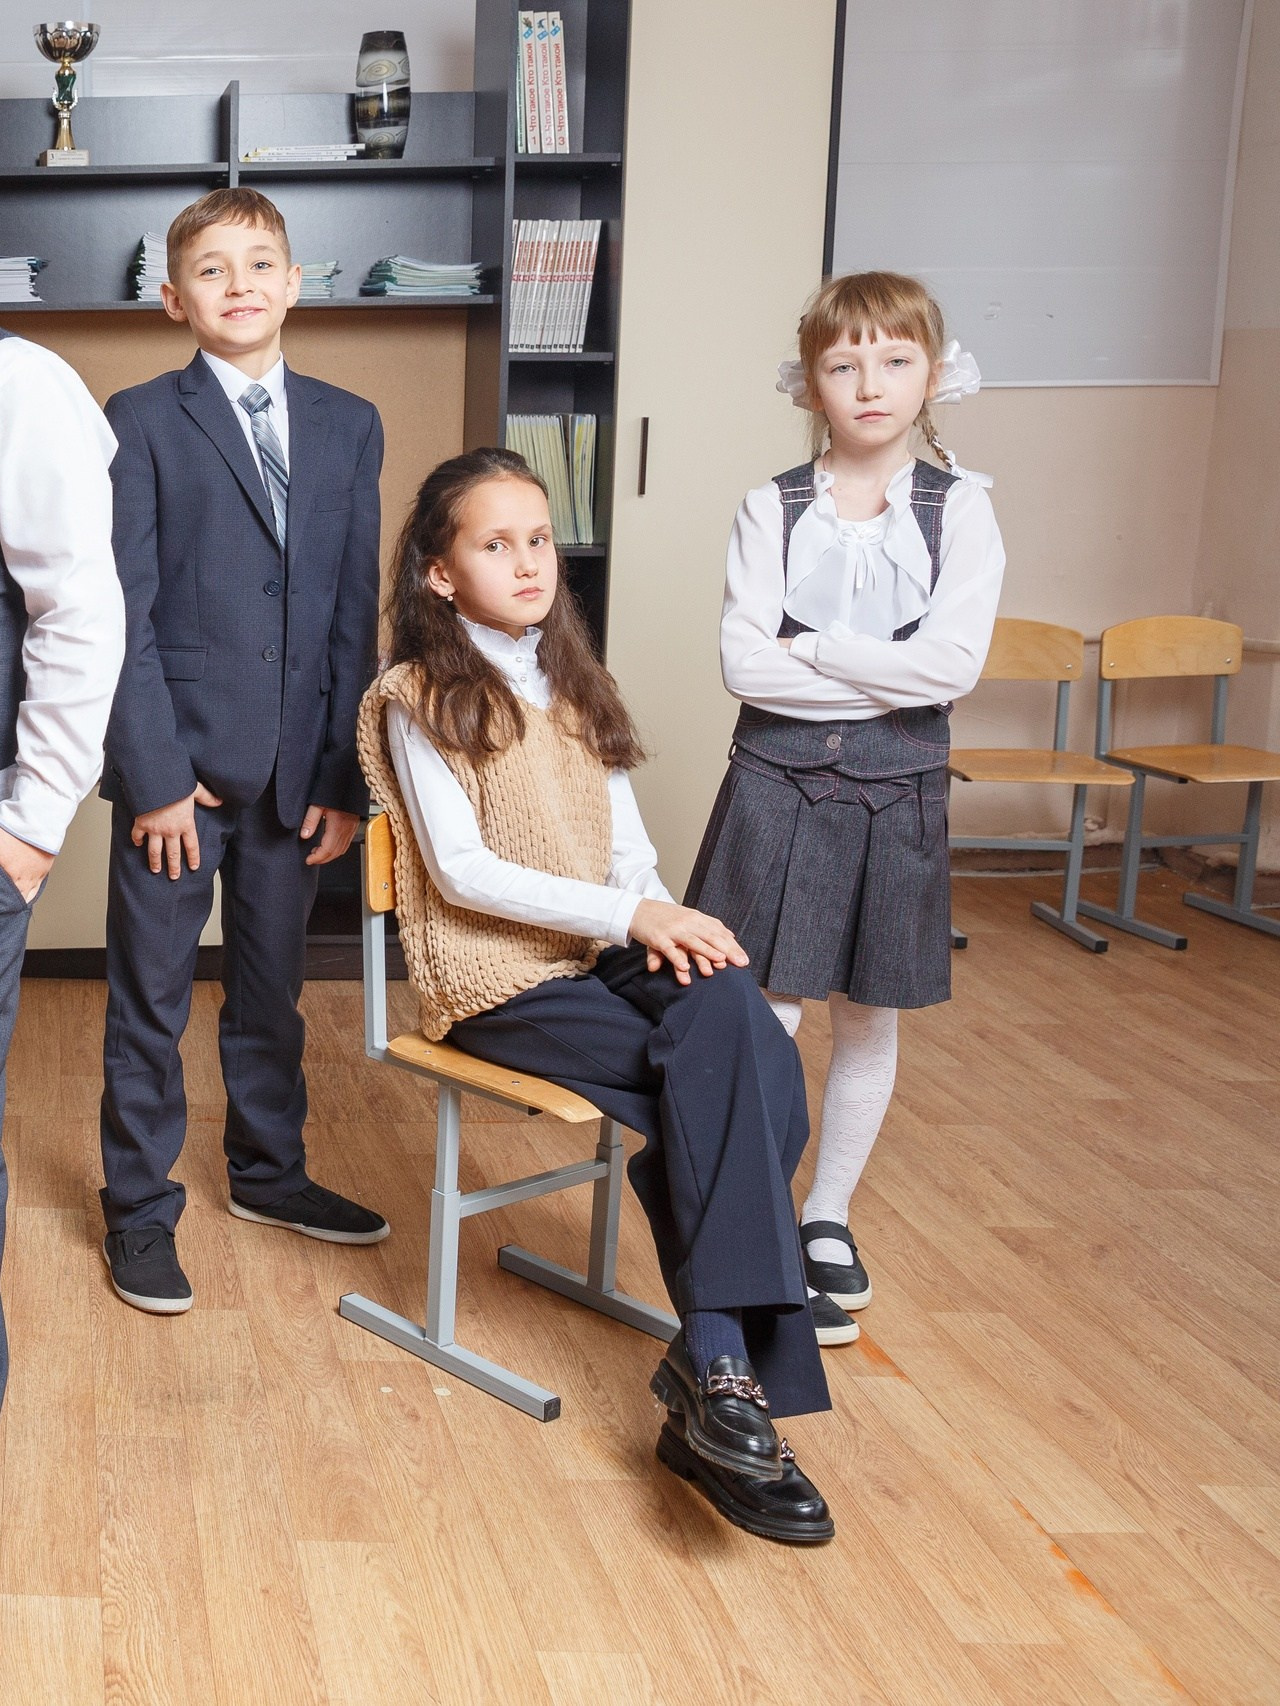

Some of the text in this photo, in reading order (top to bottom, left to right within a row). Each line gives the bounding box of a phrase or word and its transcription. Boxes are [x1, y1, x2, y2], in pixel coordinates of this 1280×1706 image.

[526, 43, 534, 69] такой
[553, 43, 561, 69] такой
[554, 70, 562, 86] Кто
[556, 88, 564, 113] такое
[529, 115, 537, 132] Что
[532, 136, 537, 145] 1
[545, 136, 553, 146] 2
[558, 136, 566, 146] 3
